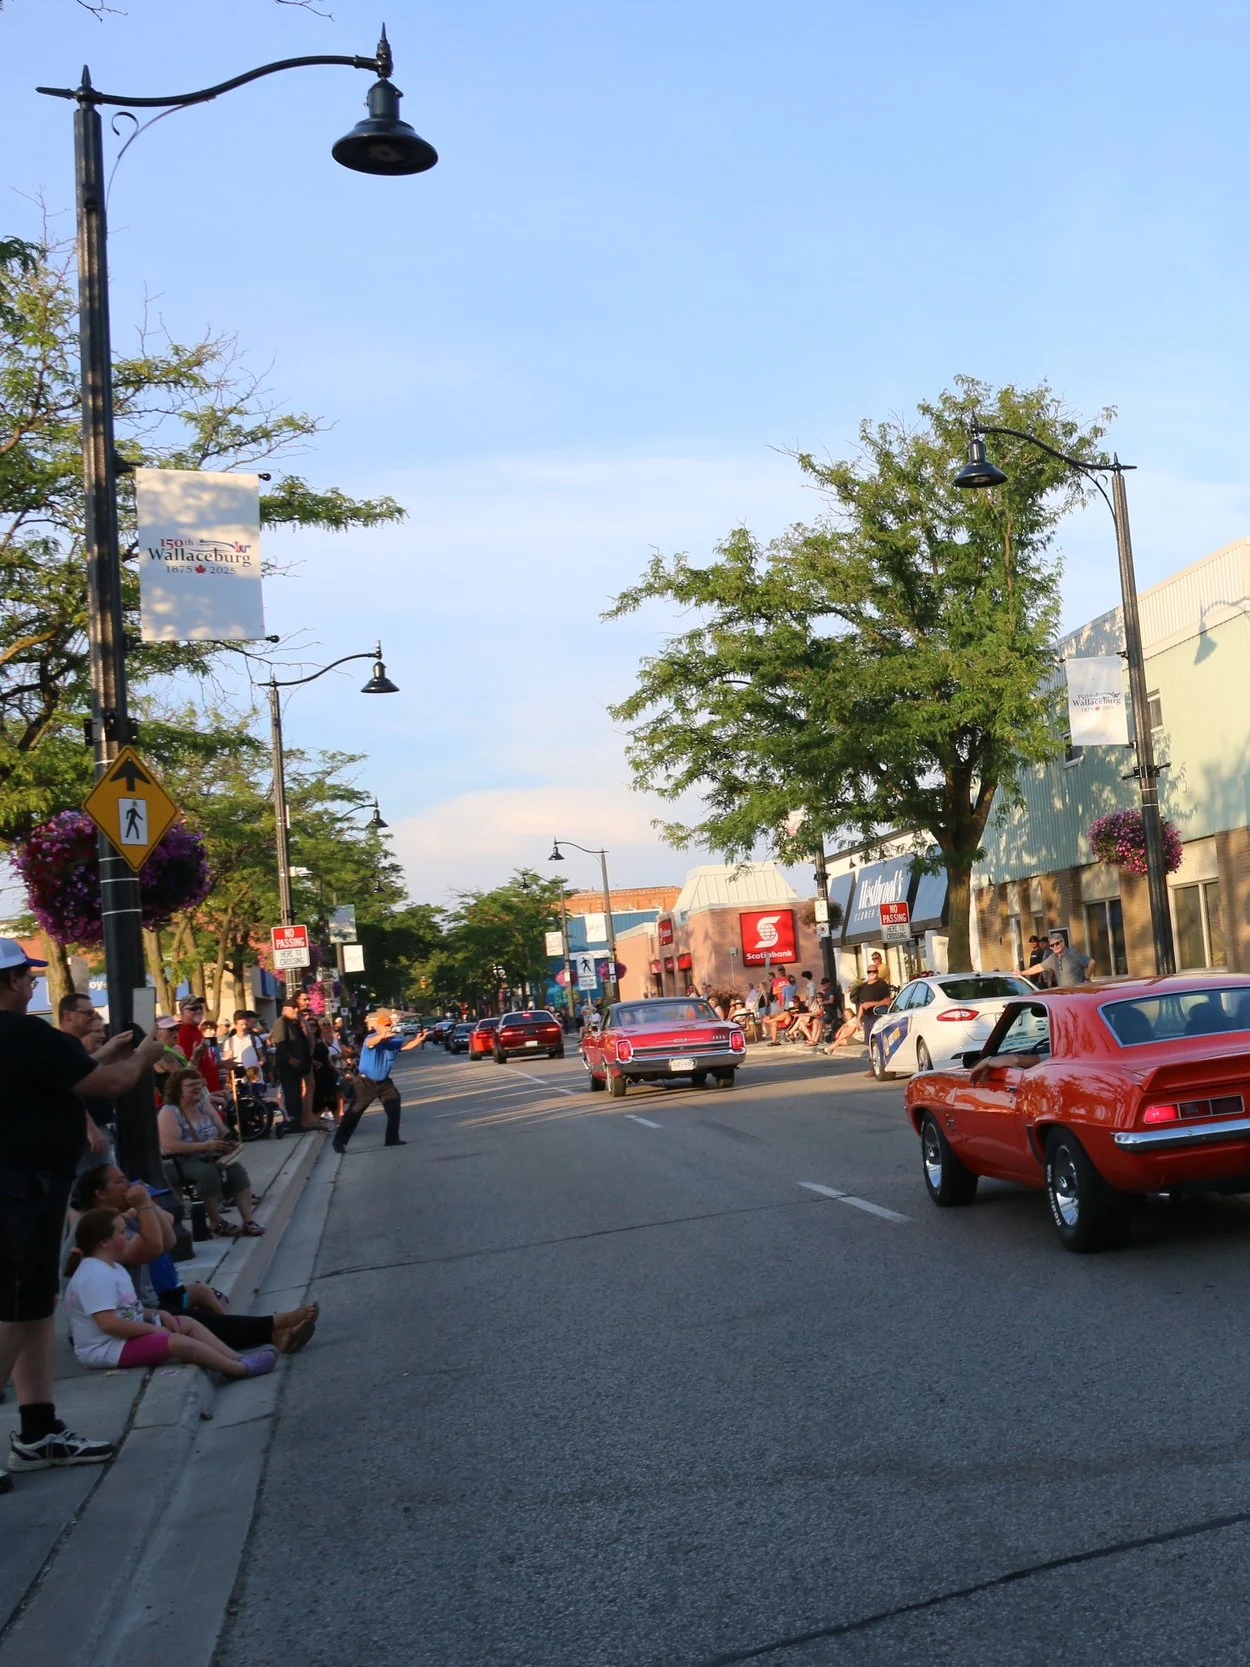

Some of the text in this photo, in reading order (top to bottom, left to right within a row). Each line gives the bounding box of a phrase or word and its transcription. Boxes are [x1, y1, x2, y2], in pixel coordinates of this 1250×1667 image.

[160, 538, 194, 550] 150th
[147, 547, 251, 567] Wallaceburg
[167, 566, 236, 575] 1875 2025
[1072, 695, 1121, 706] Wallaceburg
[858, 869, 904, 910] Westbrook's
[890, 904, 898, 913] NO
[882, 913, 907, 923] PASSING
[284, 928, 295, 938] NO
[886, 932, 907, 940] CROSSING
[276, 938, 305, 949] PASSING
